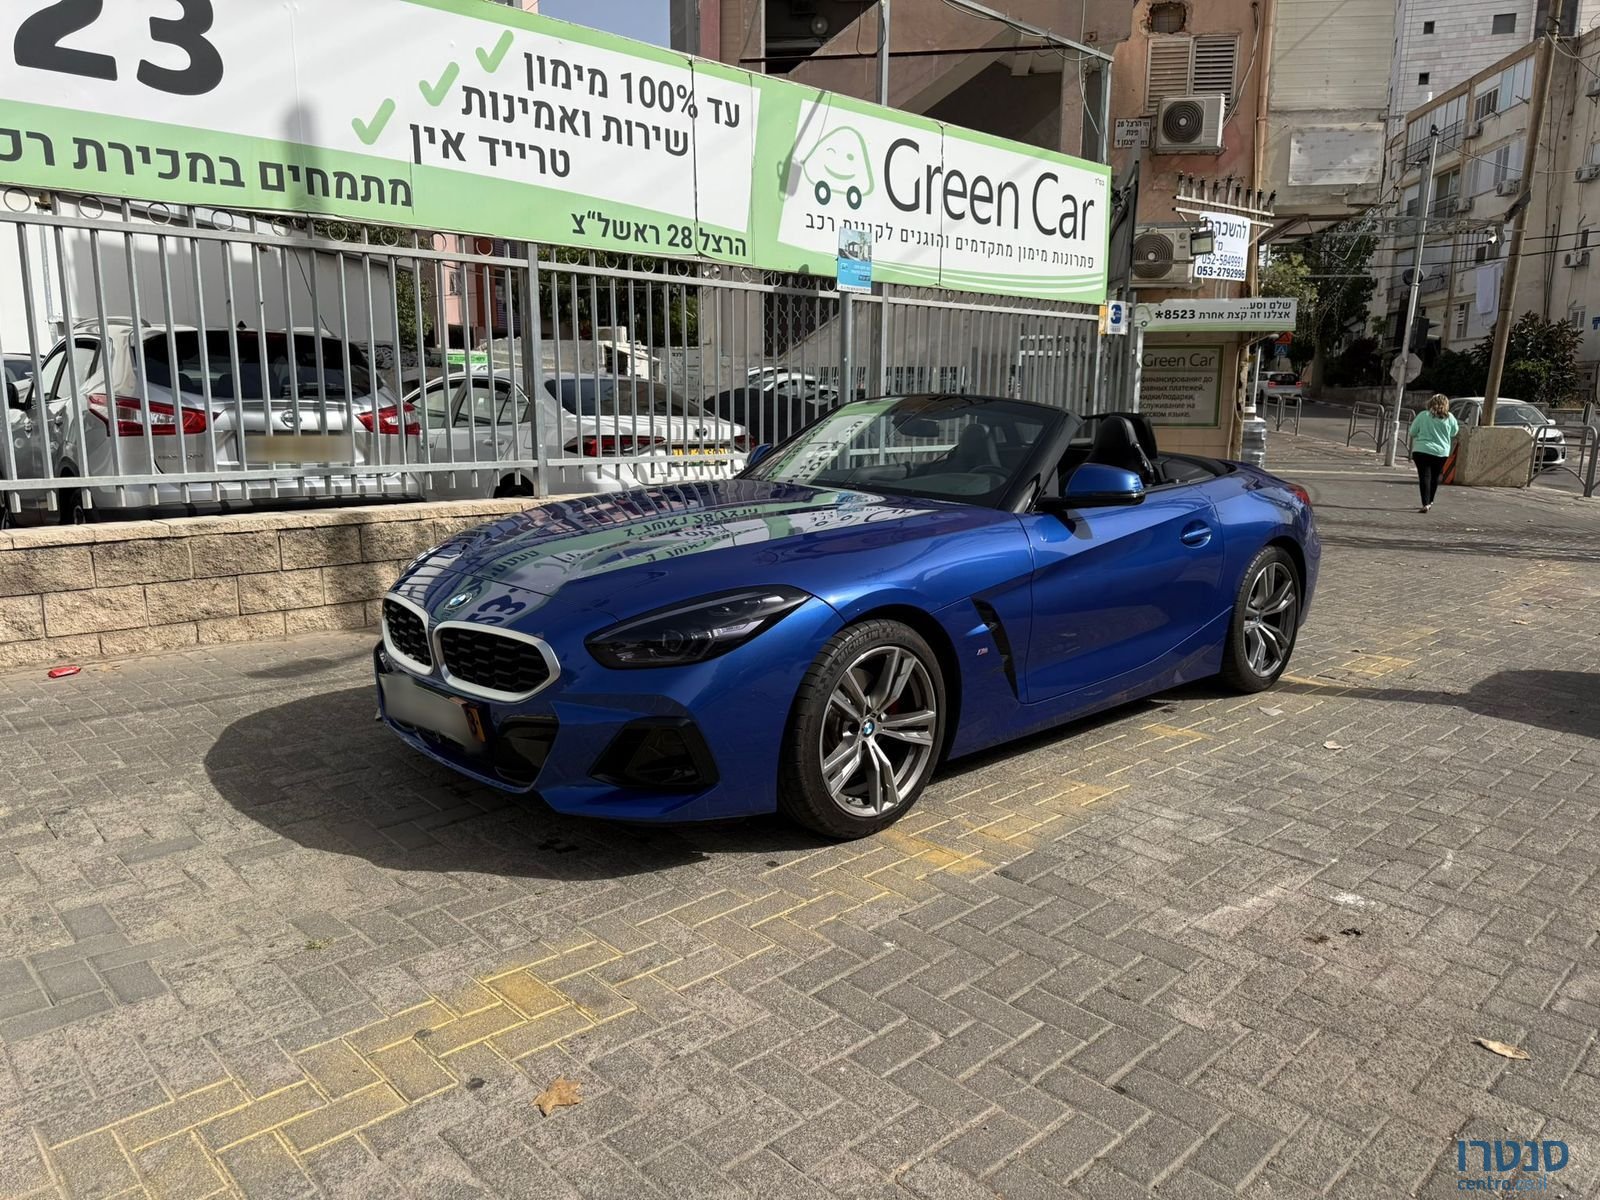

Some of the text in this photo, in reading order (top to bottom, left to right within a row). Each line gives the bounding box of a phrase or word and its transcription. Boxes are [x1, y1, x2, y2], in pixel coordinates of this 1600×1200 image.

[14, 0, 223, 95] 23
[524, 52, 740, 128] עד 100% מימון
[462, 85, 688, 157] שירות ואמינות
[410, 124, 570, 178] טרייד אין
[73, 137, 245, 188] במכירת
[258, 161, 413, 207] מתמחים
[884, 138, 1095, 241] Green Car
[806, 213, 835, 232] רכב
[667, 224, 692, 249] 28
[700, 228, 746, 257] הרצל
[900, 228, 949, 249] והוגנים
[956, 237, 1013, 258] מתקדמים
[1018, 246, 1048, 262] מימון
[1052, 251, 1094, 268] פתרונות
[1227, 311, 1247, 321] קצת
[1240, 301, 1291, 310] שלם וסע...
[1250, 311, 1262, 319] זה
[1264, 310, 1290, 319] אצלנו
[1142, 353, 1215, 367] Green Car
[1203, 376, 1213, 384] до
